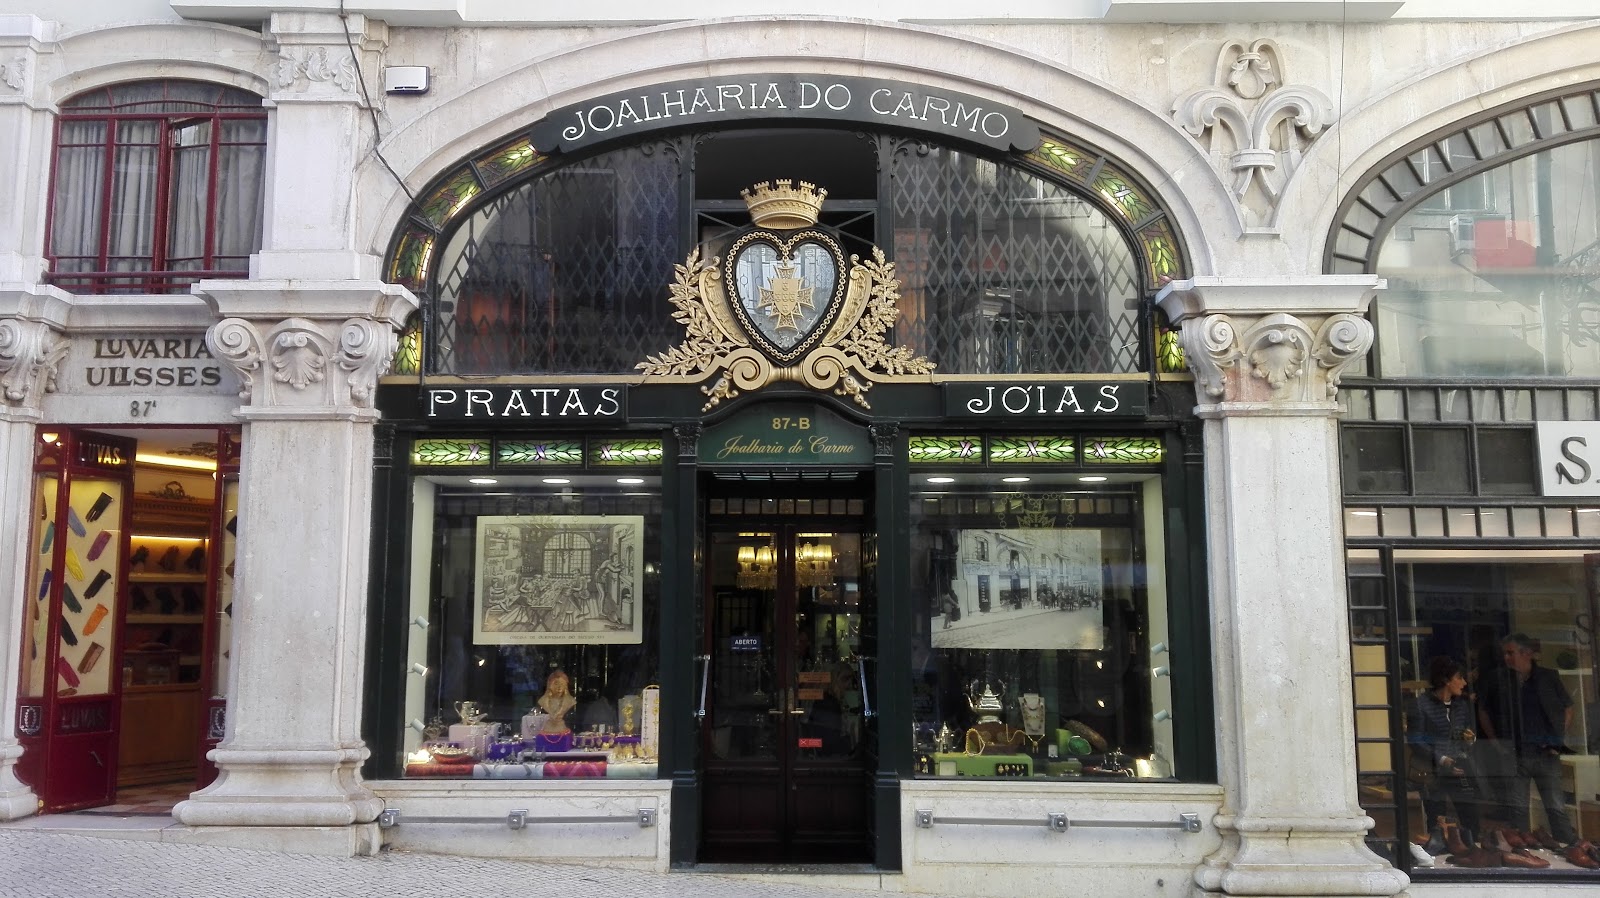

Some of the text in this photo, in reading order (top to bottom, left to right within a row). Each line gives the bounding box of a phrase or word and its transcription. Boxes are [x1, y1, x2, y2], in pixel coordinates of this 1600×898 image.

[562, 82, 1009, 141] JOALHARIA DO CARMO
[93, 338, 215, 359] LUVARIA
[428, 388, 620, 417] PRATAS
[772, 417, 811, 430] 87-B
[79, 441, 121, 465] LUVAS
[716, 434, 855, 459] Joalharia do Carmo
